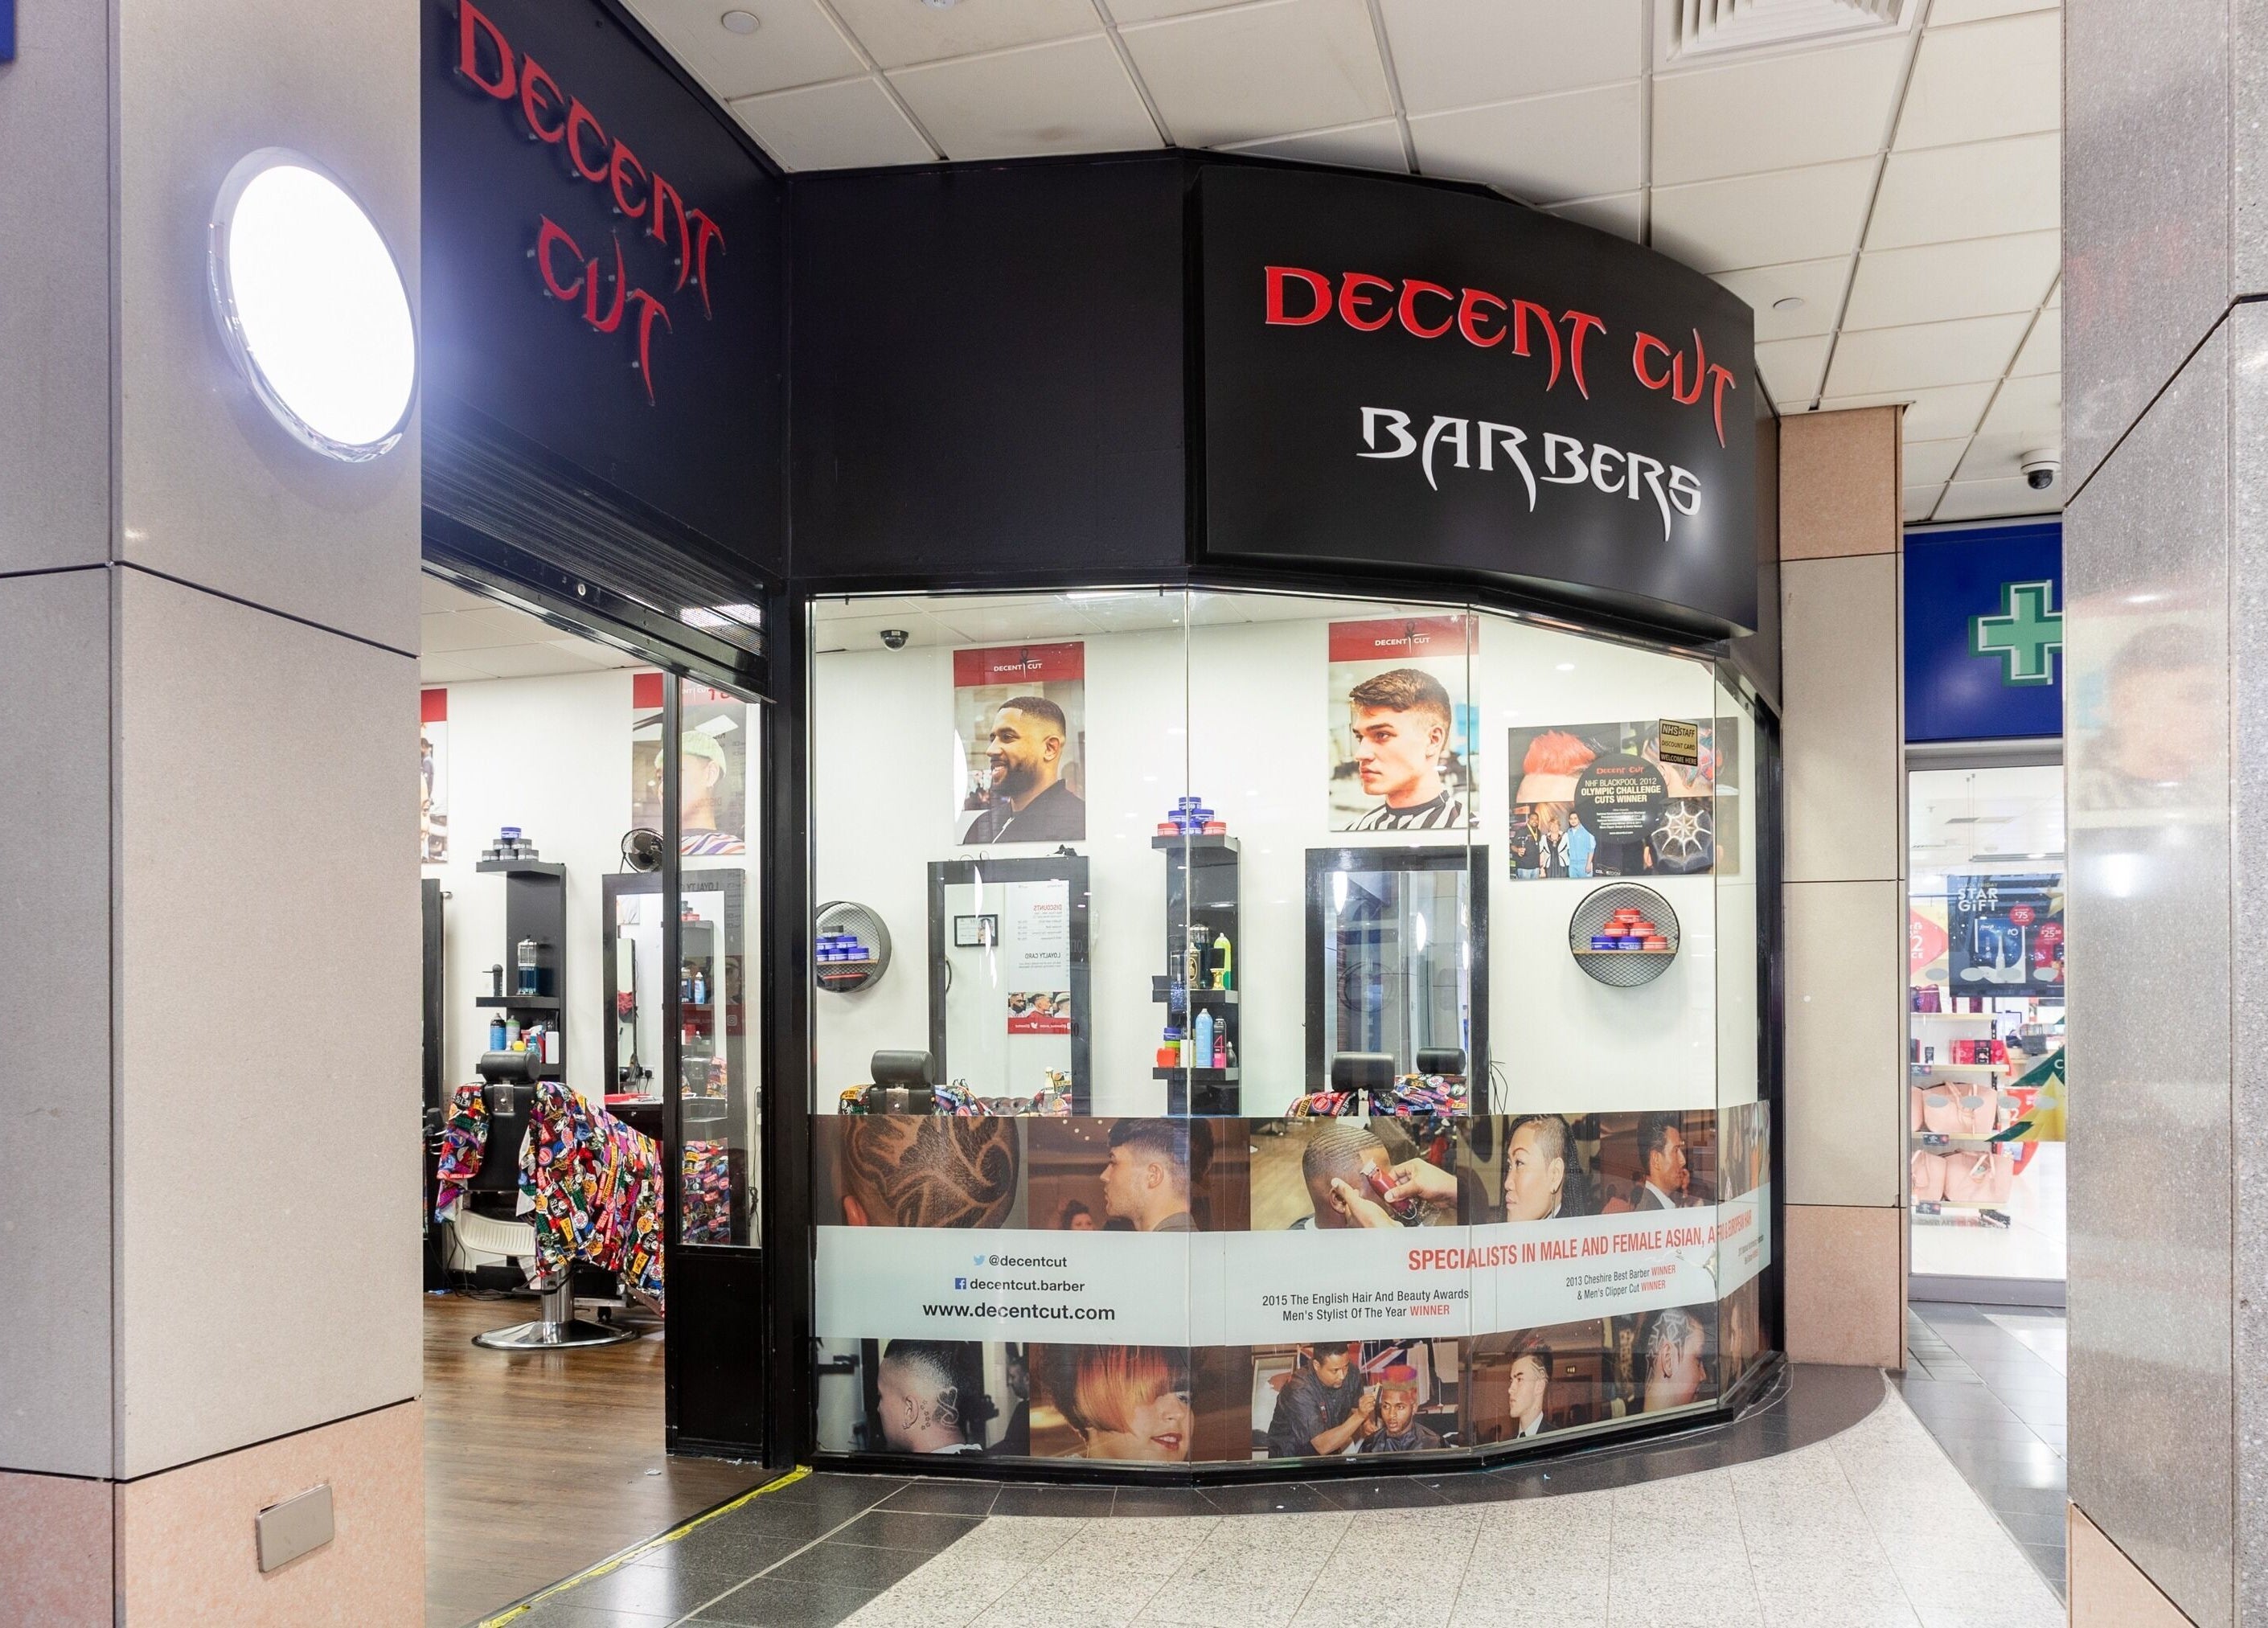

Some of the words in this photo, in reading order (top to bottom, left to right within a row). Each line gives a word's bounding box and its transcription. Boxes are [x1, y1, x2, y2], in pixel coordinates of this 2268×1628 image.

[460, 0, 725, 320] DECENT
[537, 214, 673, 406] CUT
[1265, 266, 1606, 400] DECENT
[1632, 327, 1736, 448] CUT
[1355, 406, 1702, 542] BARBERS
[1375, 638, 1407, 646] DECENT
[994, 663, 1022, 671] DECENT
[1662, 724, 1678, 736] NHS
[1679, 728, 1695, 737] STAFF
[1661, 753, 1684, 763] WELCOME
[1585, 779, 1598, 787] NHF
[1600, 778, 1638, 786] BLACKPOOL
[1639, 777, 1657, 785] 2012
[1581, 787, 1614, 796] OLYMPIC
[1616, 785, 1662, 795] CHALLENGE
[1594, 795, 1614, 804] CUTS
[1616, 794, 1647, 803] WINNER
[1958, 888, 1998, 900] STAR
[1409, 1245, 1517, 1270] SPECIALISTS
[1522, 1244, 1535, 1263] IN
[1540, 1239, 1577, 1261] MALE
[1581, 1235, 1608, 1257] AND
[1613, 1230, 1662, 1253] FEMALE
[1665, 1227, 1704, 1249] ASIAN,
[989, 1254, 1068, 1269] @decentcut
[1566, 1277, 1582, 1287] 2013
[1584, 1273, 1612, 1285] Cheshire
[1614, 1271, 1627, 1281] Best
[1629, 1269, 1650, 1279] Barber
[1651, 1265, 1676, 1276] WINNER
[970, 1277, 1085, 1293] decentcut.barber
[1577, 1291, 1582, 1300] &
[1584, 1288, 1604, 1299] Men's
[1605, 1286, 1627, 1298] Clipper
[1629, 1283, 1640, 1294] Cut
[1641, 1280, 1666, 1291] WINNER
[1262, 1295, 1288, 1306] 2015
[1290, 1294, 1309, 1306] The
[1312, 1292, 1348, 1306] English
[1352, 1291, 1372, 1303] Hair
[1375, 1290, 1394, 1302] And
[1397, 1289, 1431, 1302] Beauty
[1433, 1289, 1470, 1300] Awards
[922, 1302, 1116, 1321] www.decentcut.com
[1282, 1310, 1313, 1322] Men's
[1316, 1308, 1348, 1322] Stylist
[1351, 1307, 1362, 1318] Of
[1364, 1306, 1383, 1318] The
[1385, 1306, 1407, 1318] Year
[1409, 1304, 1450, 1317] WINNER
